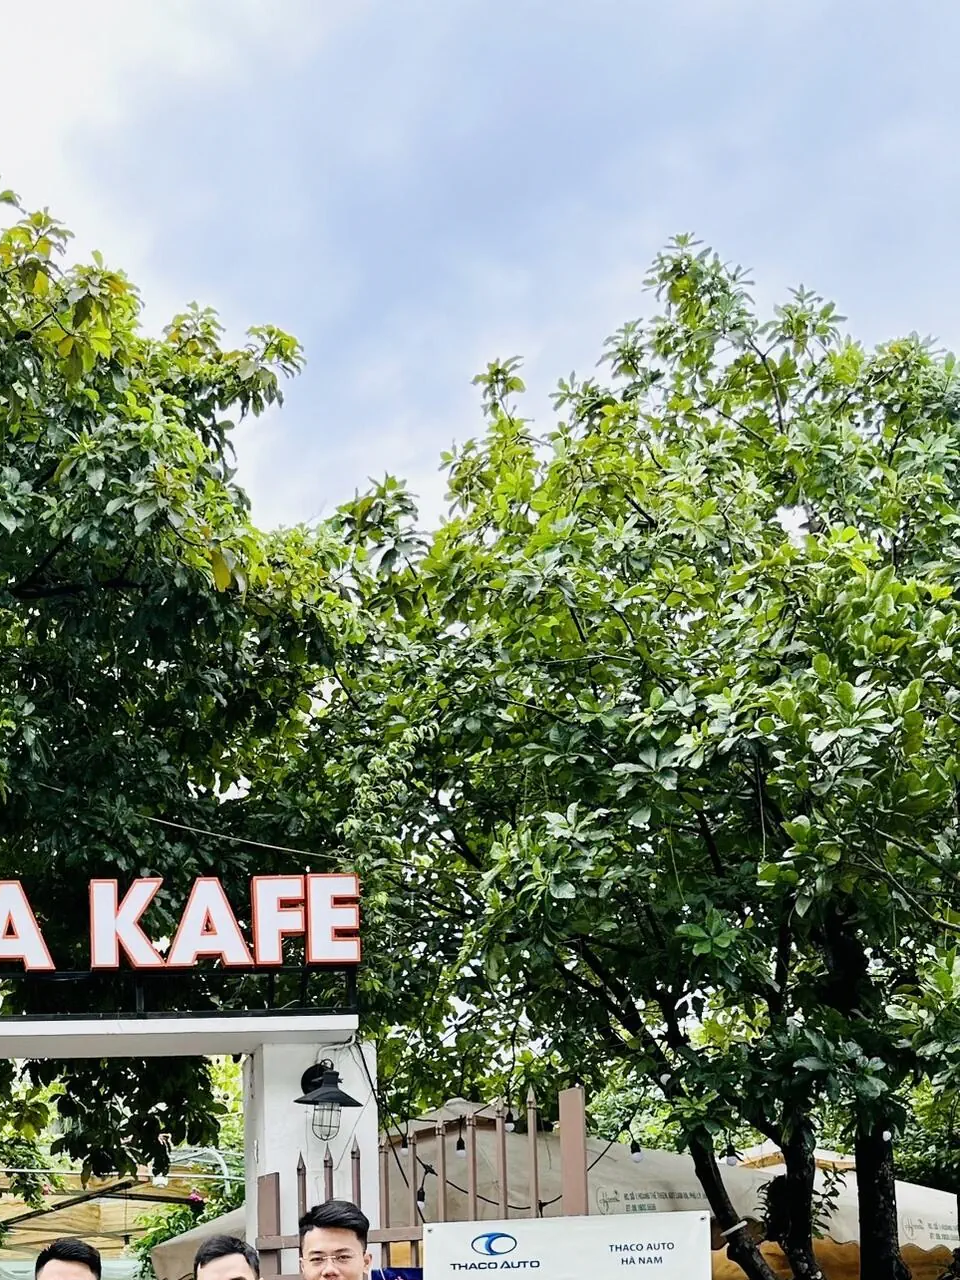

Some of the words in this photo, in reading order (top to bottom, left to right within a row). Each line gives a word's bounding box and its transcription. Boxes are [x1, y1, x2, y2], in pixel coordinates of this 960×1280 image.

[89, 873, 362, 971] KAFE
[609, 1243, 644, 1252] THACO
[646, 1242, 675, 1251] AUTO
[450, 1262, 498, 1270] THACO
[500, 1260, 540, 1269] AUTO
[621, 1256, 636, 1265] HÀ
[638, 1256, 663, 1264] NAM
